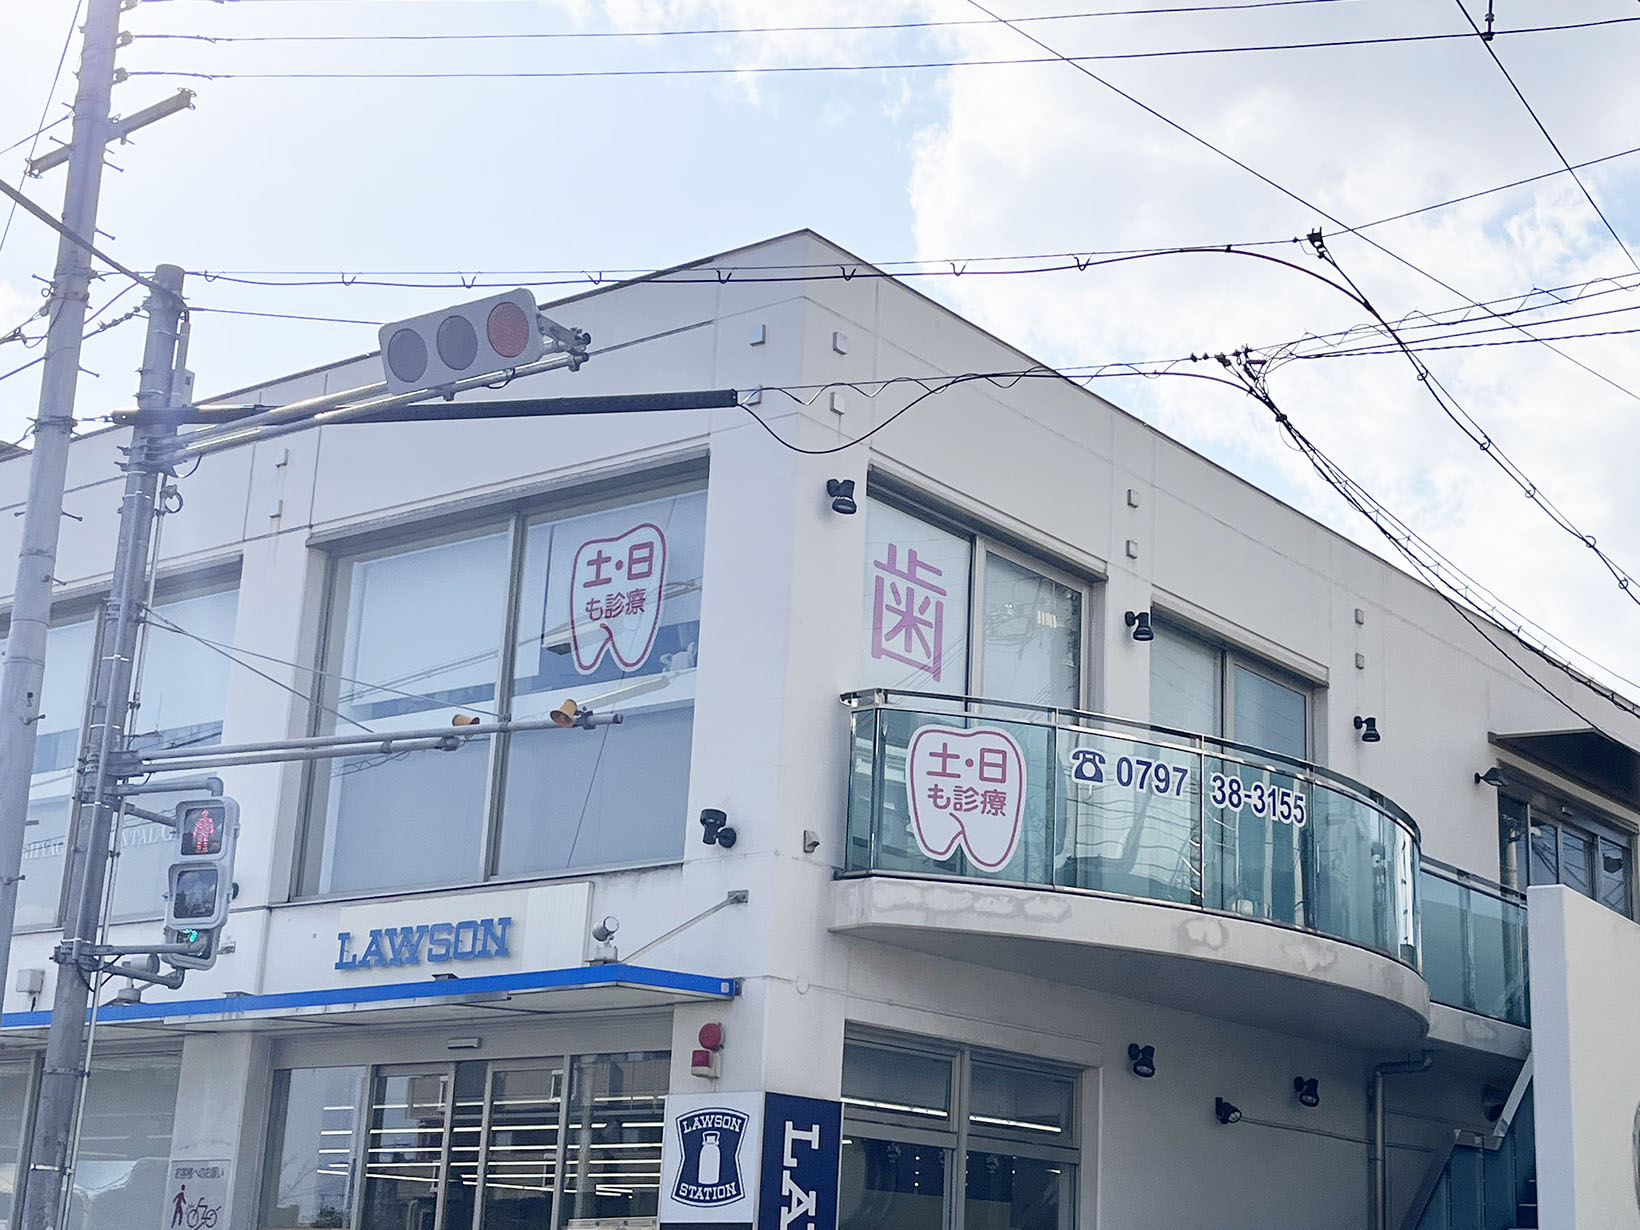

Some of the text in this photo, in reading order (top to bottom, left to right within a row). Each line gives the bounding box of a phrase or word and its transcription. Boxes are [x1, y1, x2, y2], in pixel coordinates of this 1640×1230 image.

[583, 541, 654, 588] 土・日
[585, 588, 646, 621] も診療
[871, 543, 947, 682] 歯
[926, 742, 1007, 784] 土・日
[927, 784, 1007, 817] も診療
[1116, 756, 1305, 824] 0797 38-3155
[334, 916, 512, 970] LAWSON
[682, 1114, 742, 1134] LAWSON
[679, 1181, 737, 1200] STATION
[780, 1120, 820, 1230] LA
